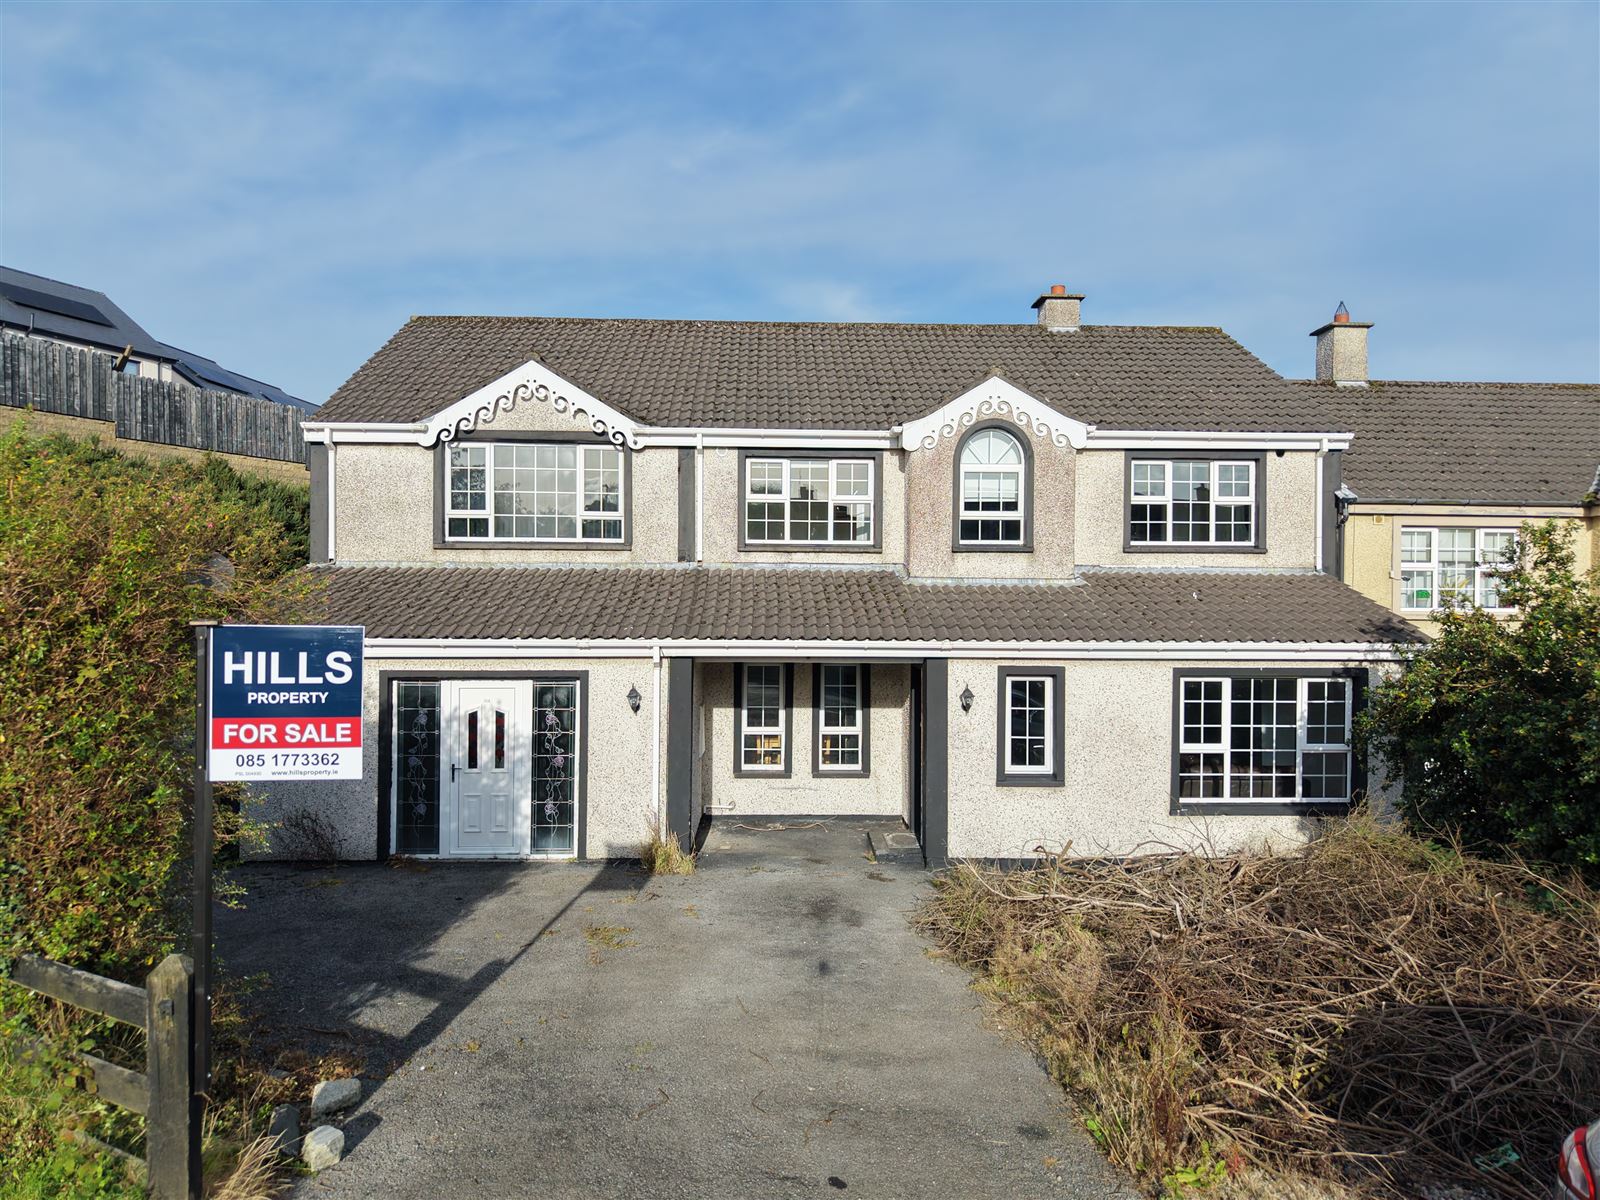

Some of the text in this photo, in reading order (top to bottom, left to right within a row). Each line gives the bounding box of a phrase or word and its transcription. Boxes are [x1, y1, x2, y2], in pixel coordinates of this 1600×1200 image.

[224, 651, 353, 684] HILLS
[247, 692, 328, 704] PROPERTY
[223, 723, 352, 744] FOR SALE
[235, 753, 340, 767] 085 1773362
